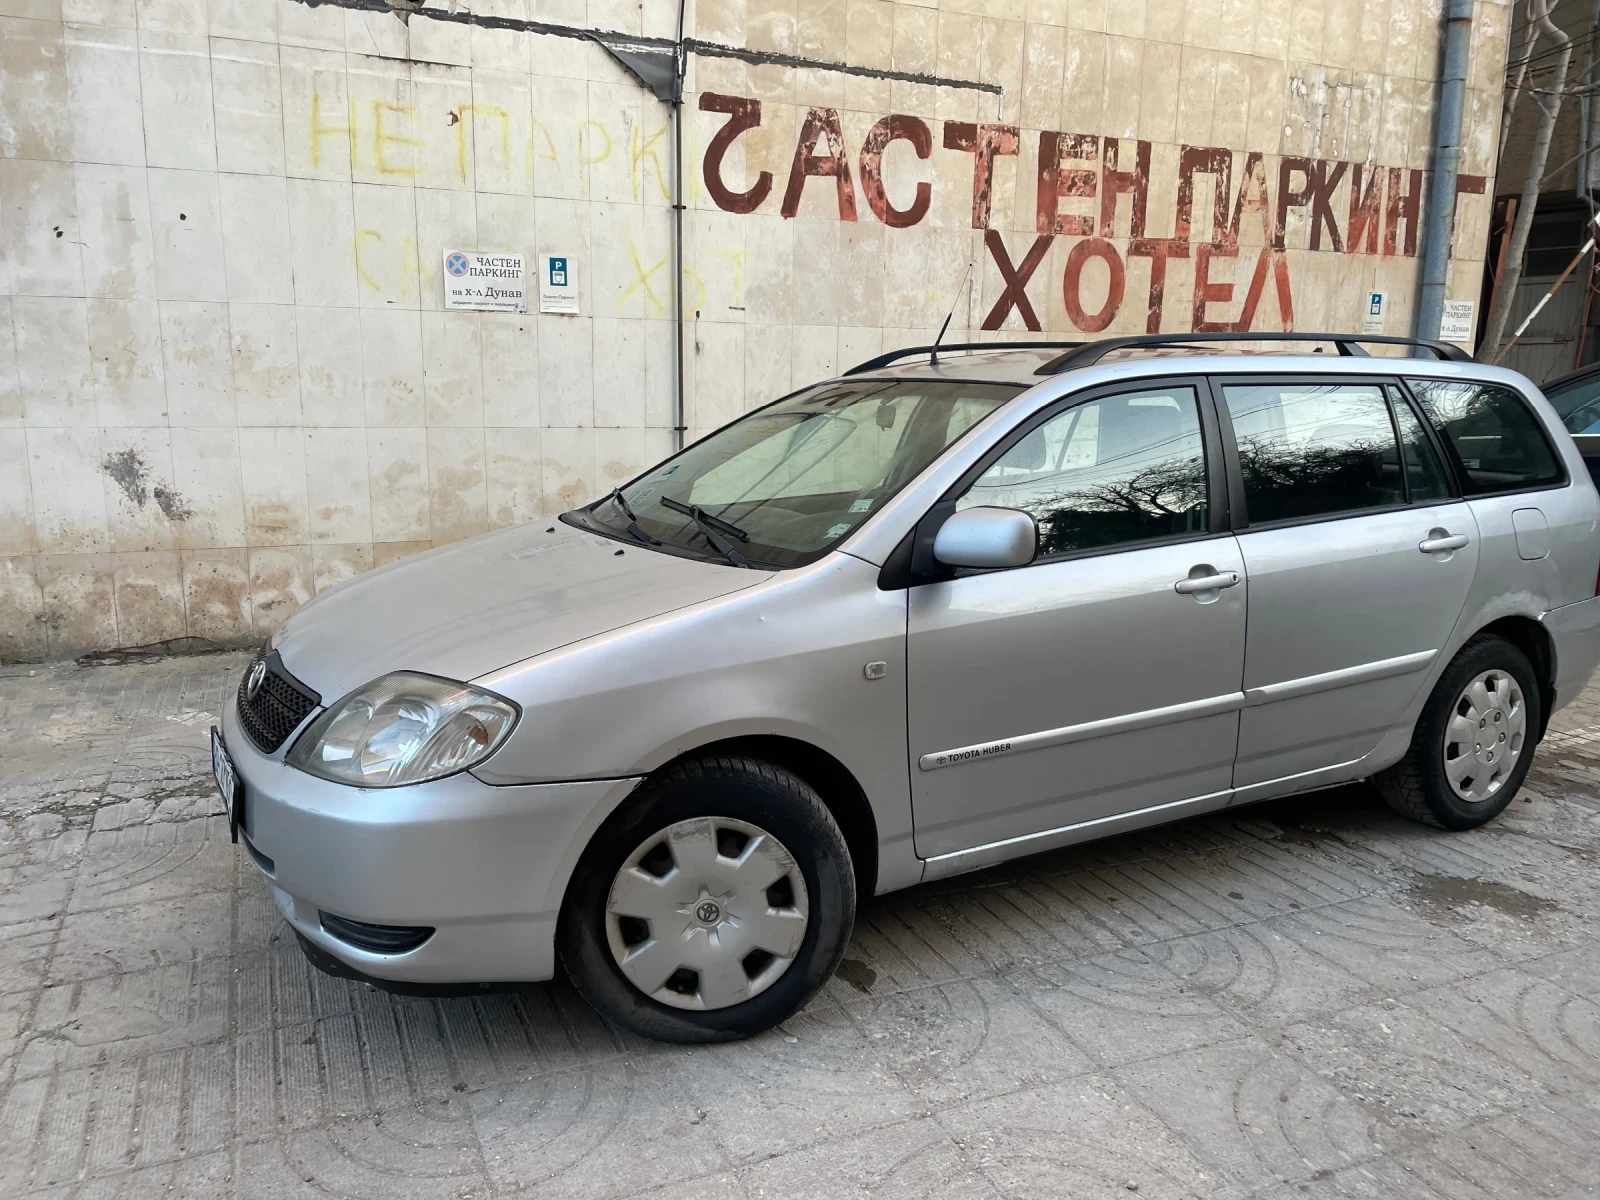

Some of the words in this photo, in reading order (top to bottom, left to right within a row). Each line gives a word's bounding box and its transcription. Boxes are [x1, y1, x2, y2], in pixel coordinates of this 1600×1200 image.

[307, 89, 427, 180] НЕ
[1177, 145, 1486, 258] ПАРКИНГ
[476, 257, 521, 268] ЧАСТЕН
[469, 267, 522, 279] ПАРКИНГ
[981, 228, 1294, 335] ХОТЕЛ
[484, 287, 522, 299] Дунав
[1450, 304, 1472, 312] ЧАСТЕН
[1445, 311, 1472, 319] ПАРКИНГ
[948, 749, 980, 763] TOYOTA
[982, 743, 1011, 756] HUBER
